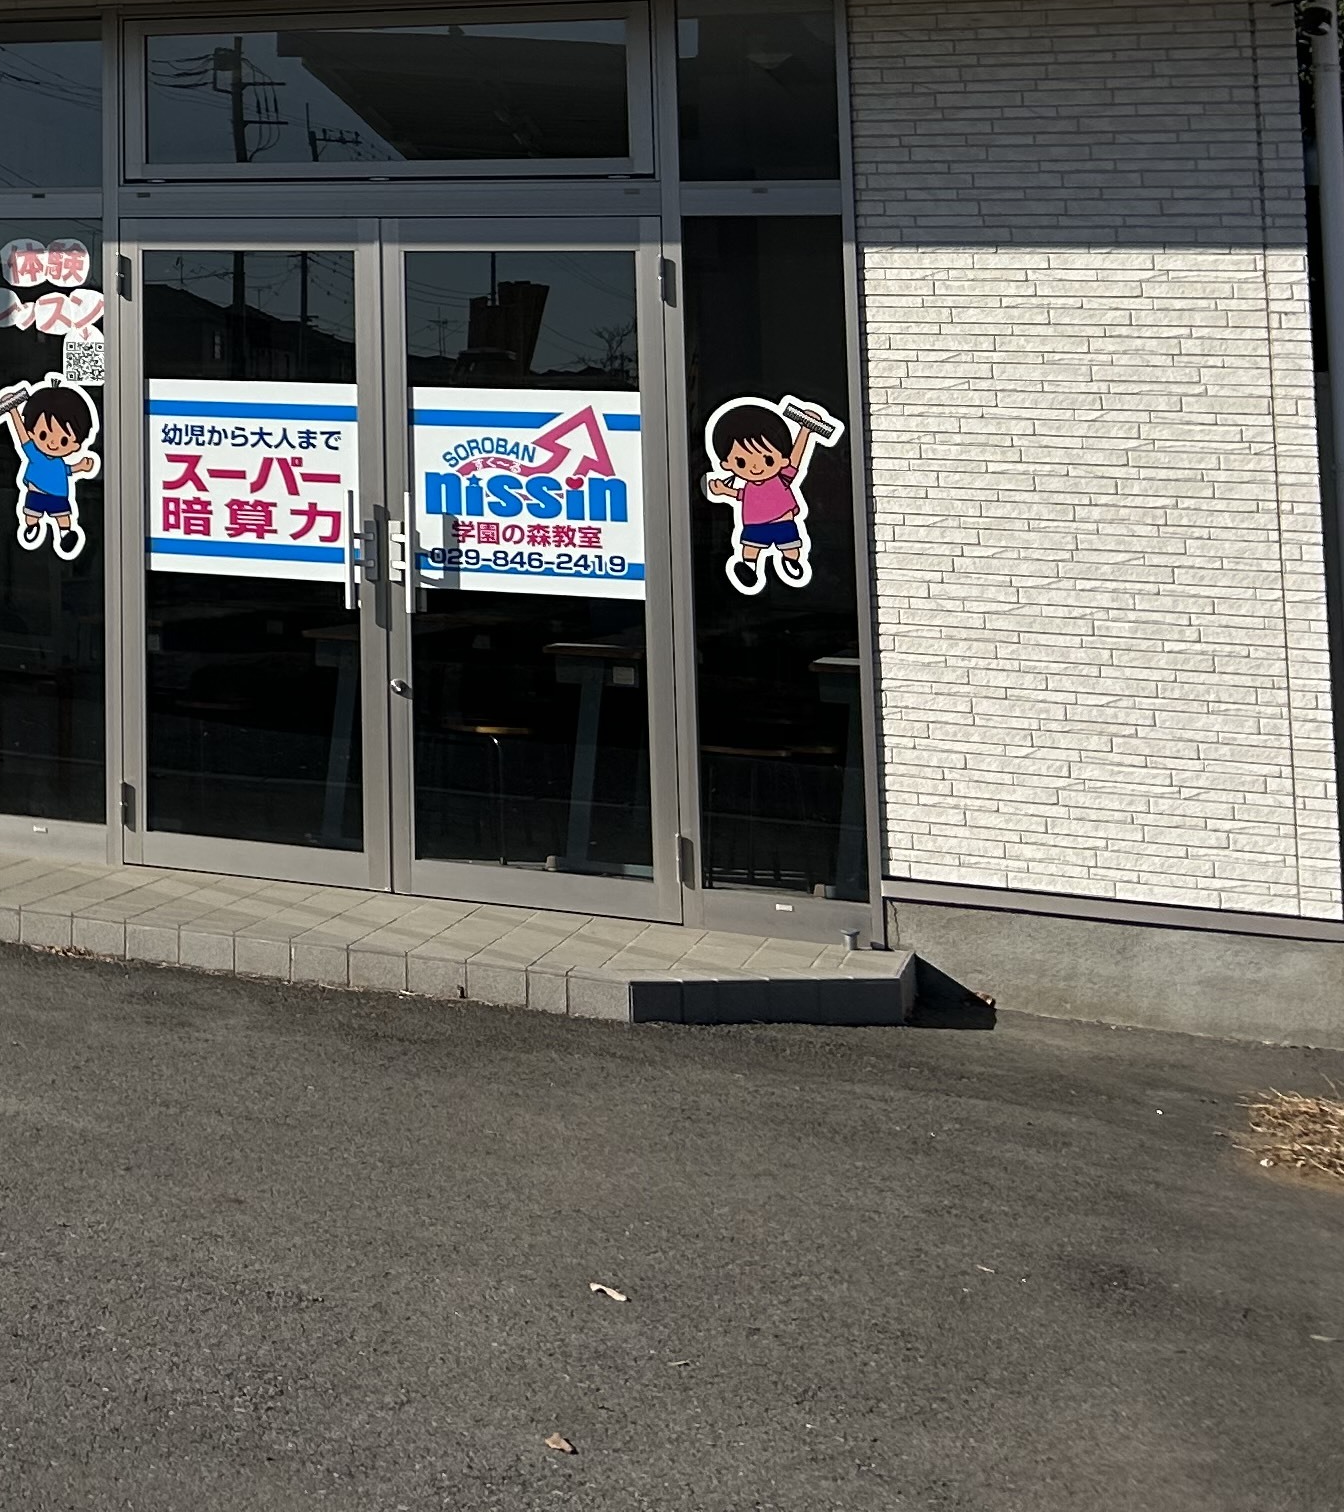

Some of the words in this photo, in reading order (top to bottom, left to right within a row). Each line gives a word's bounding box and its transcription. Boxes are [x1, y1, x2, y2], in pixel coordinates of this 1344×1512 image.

[7, 242, 87, 285] 体験
[161, 423, 342, 451] 幼児から大人まで
[442, 436, 537, 468] SOROBAN
[162, 453, 342, 496] スーパー
[425, 471, 628, 523] nissin
[162, 496, 342, 544] 暗算力
[451, 520, 604, 550] 学園の森教室
[430, 546, 626, 573] 029-846-2419
